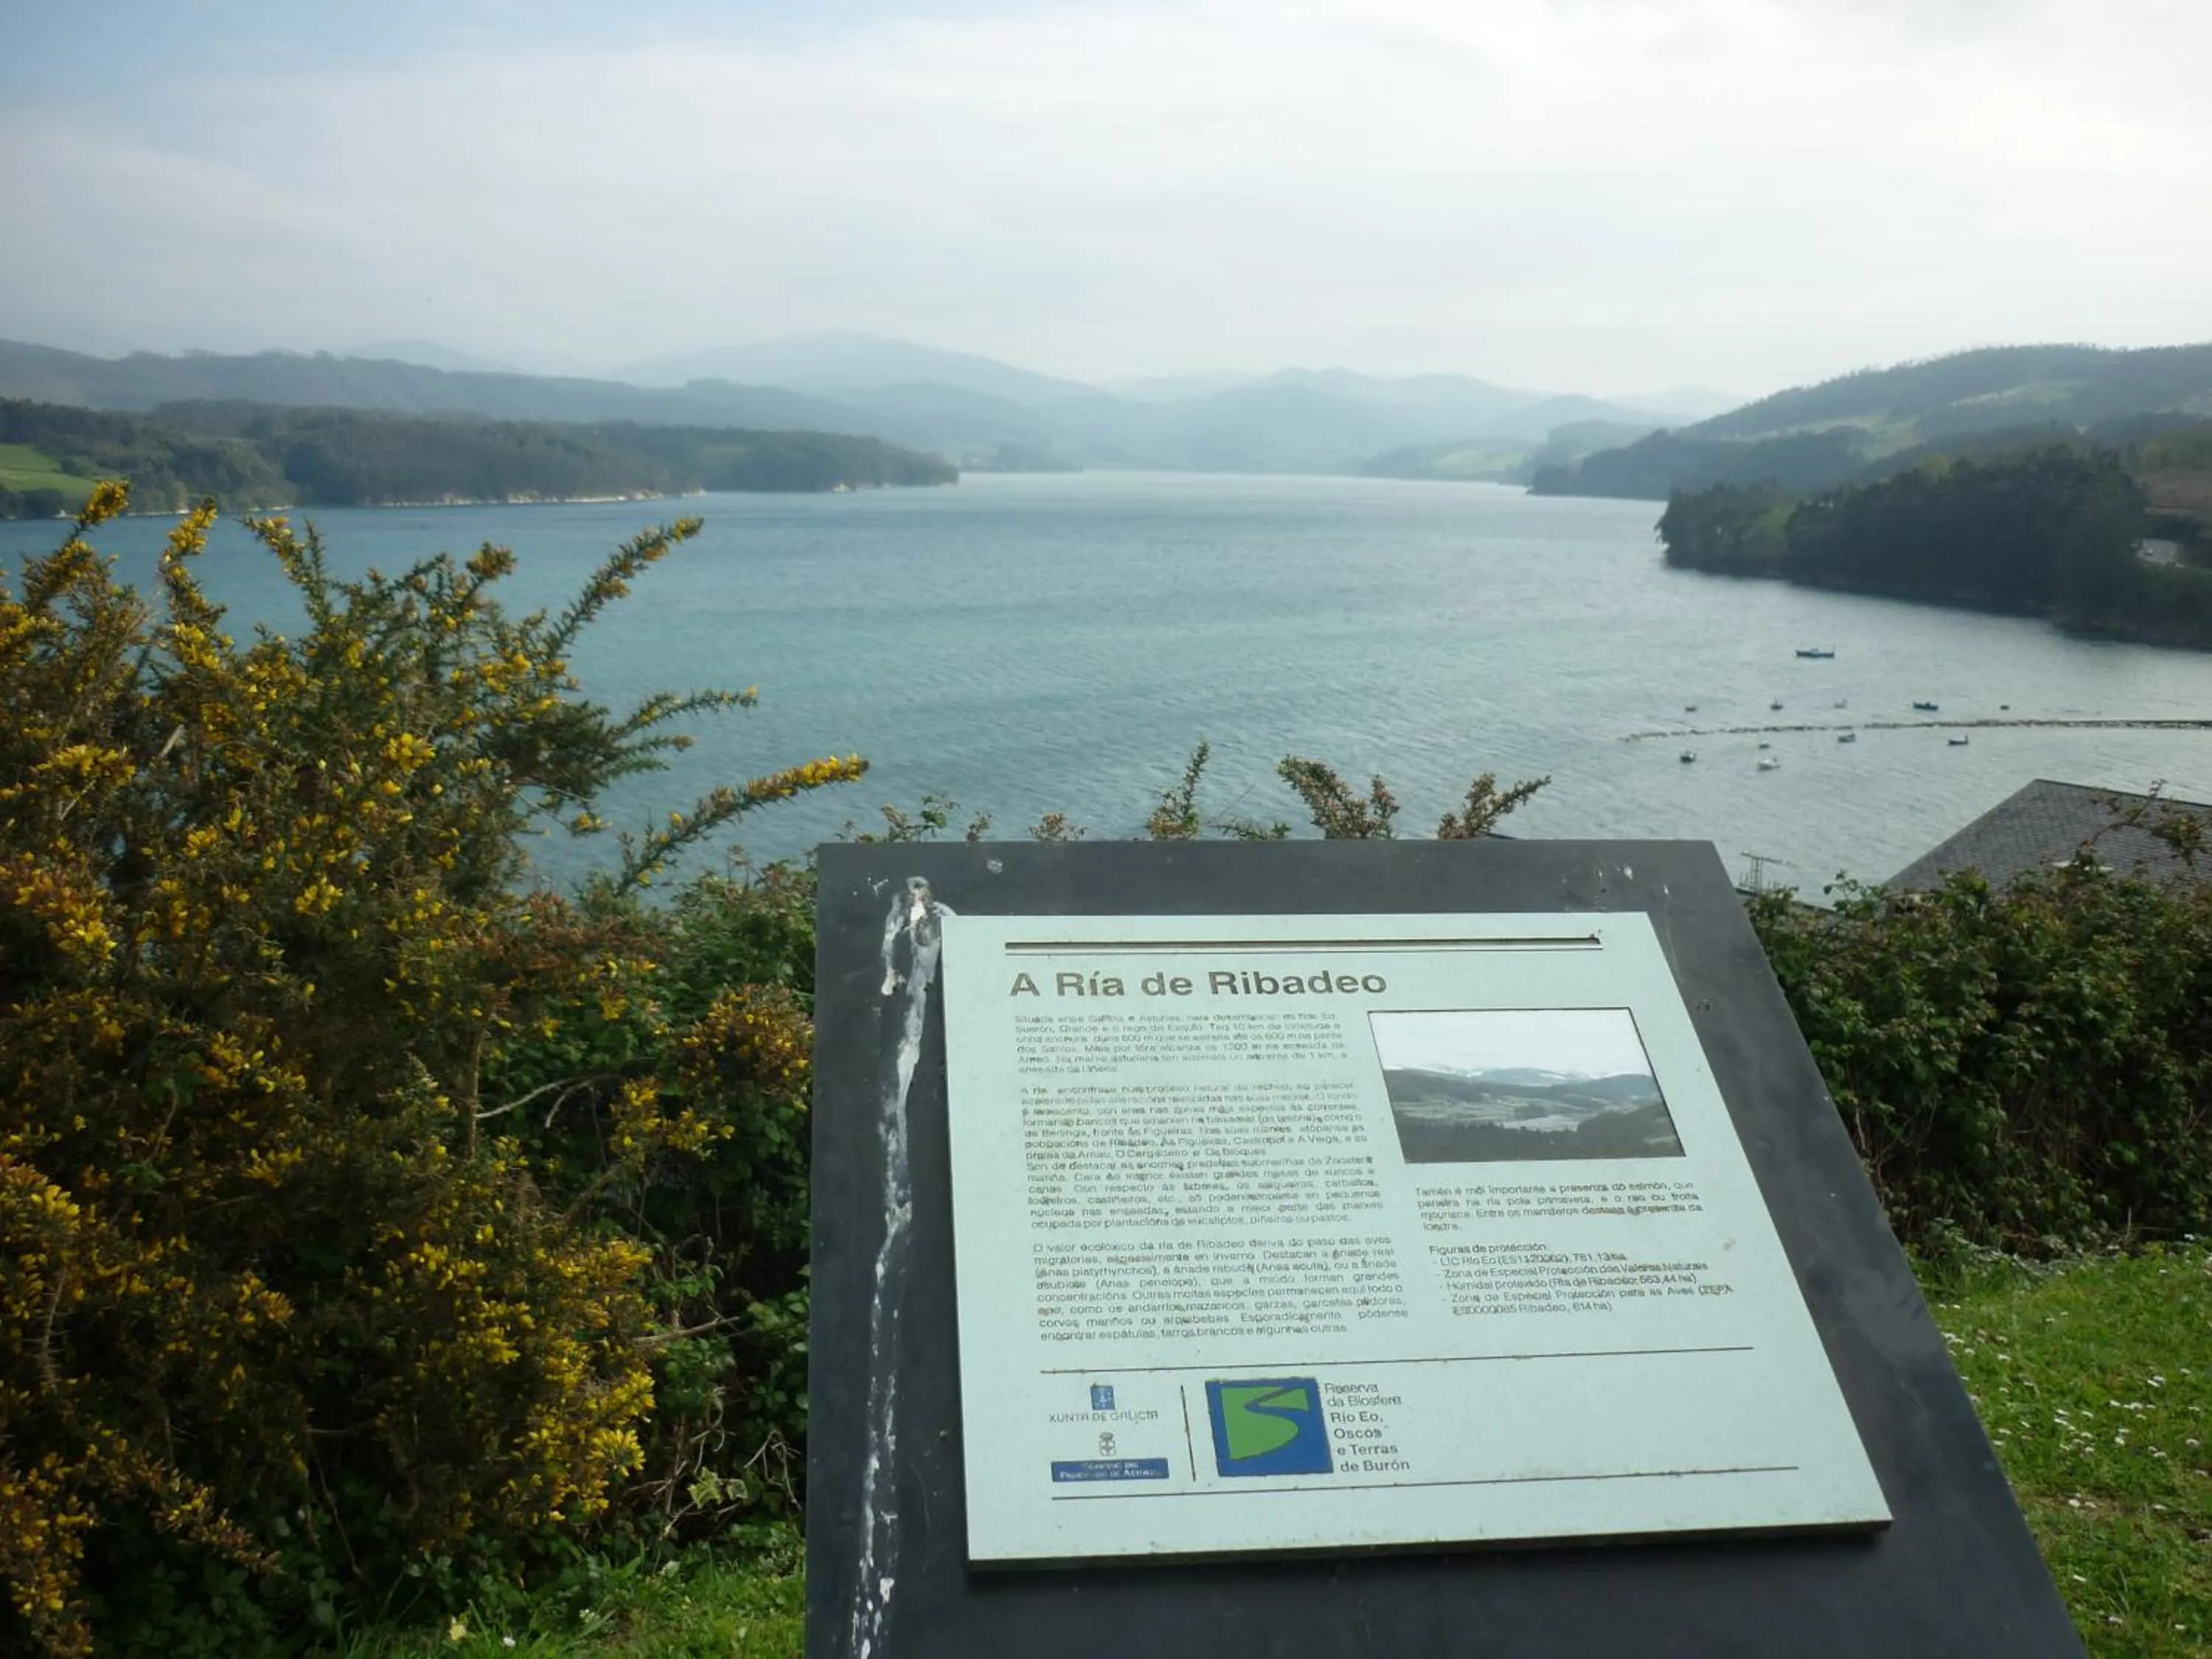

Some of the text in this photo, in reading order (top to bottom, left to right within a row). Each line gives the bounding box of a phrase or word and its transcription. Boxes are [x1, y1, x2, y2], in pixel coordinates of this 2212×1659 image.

[1009, 970, 1388, 996] A Ría de Ribadeo
[1326, 1397, 1344, 1407] da
[1334, 1428, 1382, 1439] Oscos
[1337, 1444, 1399, 1456] e Terras
[1340, 1459, 1411, 1472] de Burón
